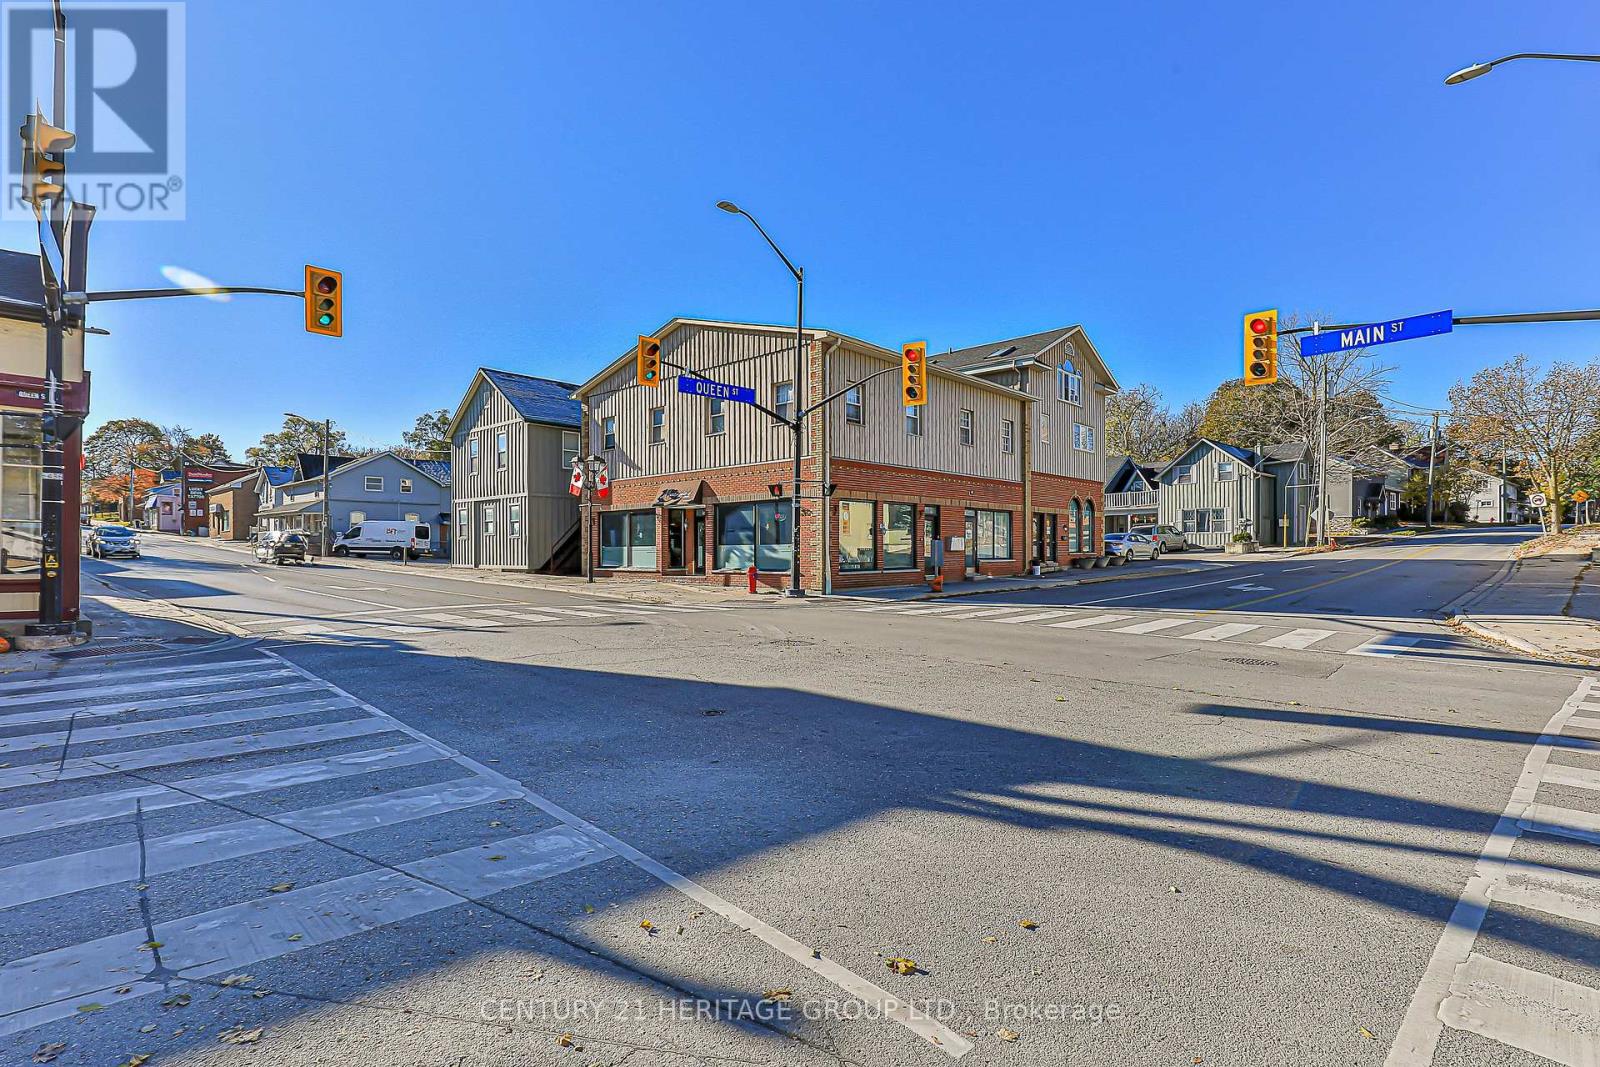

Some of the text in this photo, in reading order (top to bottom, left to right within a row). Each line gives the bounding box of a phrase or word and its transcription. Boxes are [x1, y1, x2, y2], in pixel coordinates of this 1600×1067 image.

[1341, 321, 1404, 349] MAIN ST
[696, 381, 739, 398] QUEEN ST
